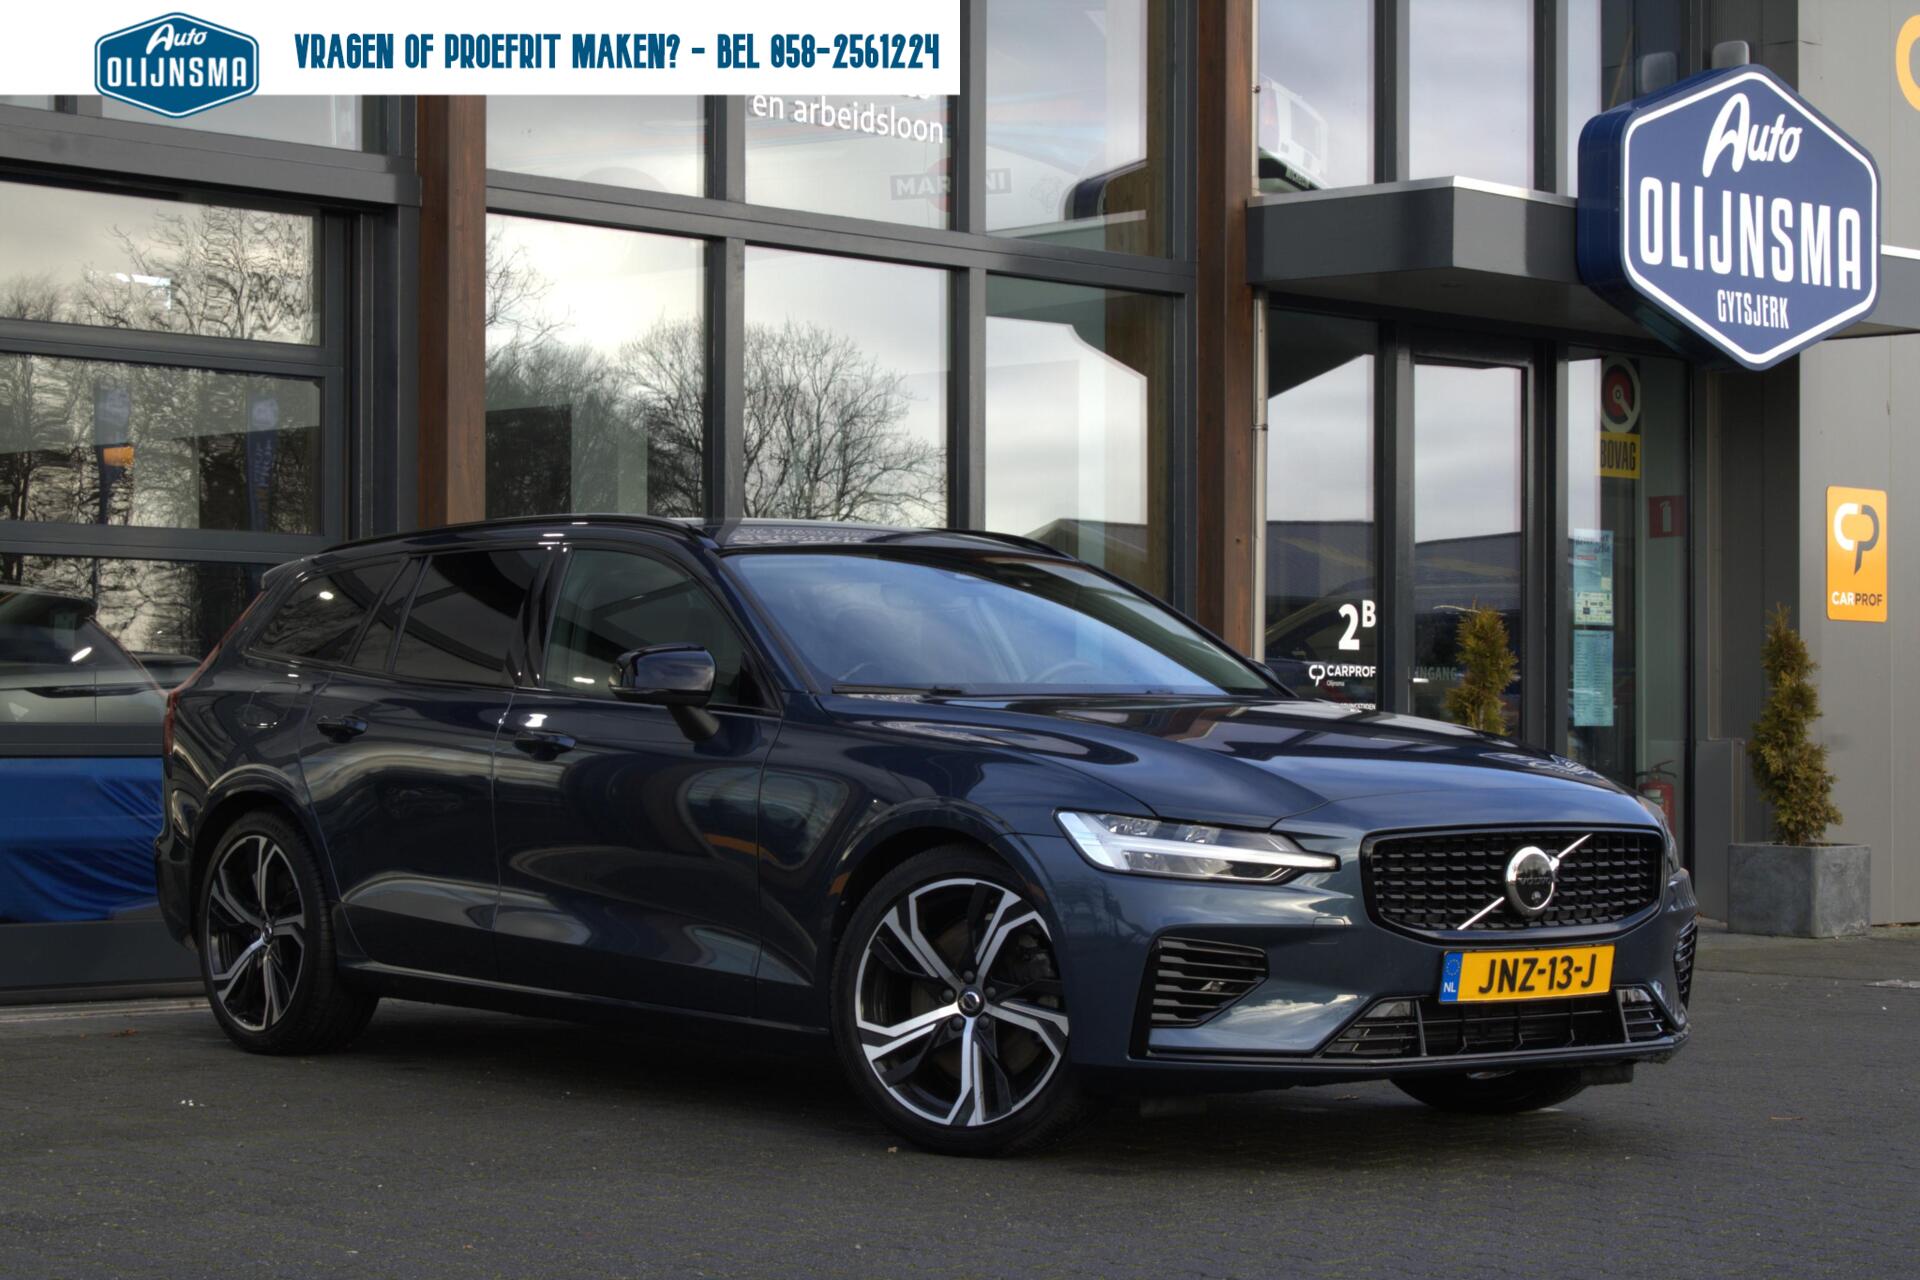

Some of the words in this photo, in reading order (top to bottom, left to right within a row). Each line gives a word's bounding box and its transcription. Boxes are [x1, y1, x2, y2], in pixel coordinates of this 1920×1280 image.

[752, 94, 784, 119] en
[793, 95, 944, 144] arbeidsloon
[1702, 92, 1802, 178] Auto
[895, 170, 1006, 196] MARNI
[1639, 176, 1861, 290] OLIJNSMA
[1717, 289, 1789, 329] GYTSJERK
[1600, 439, 1636, 472] BOVAG
[1831, 591, 1883, 607] CARPROF
[1326, 664, 1376, 677] CARPROF
[1443, 981, 1457, 993] NL
[1478, 954, 1597, 994] JNZ-13-J
